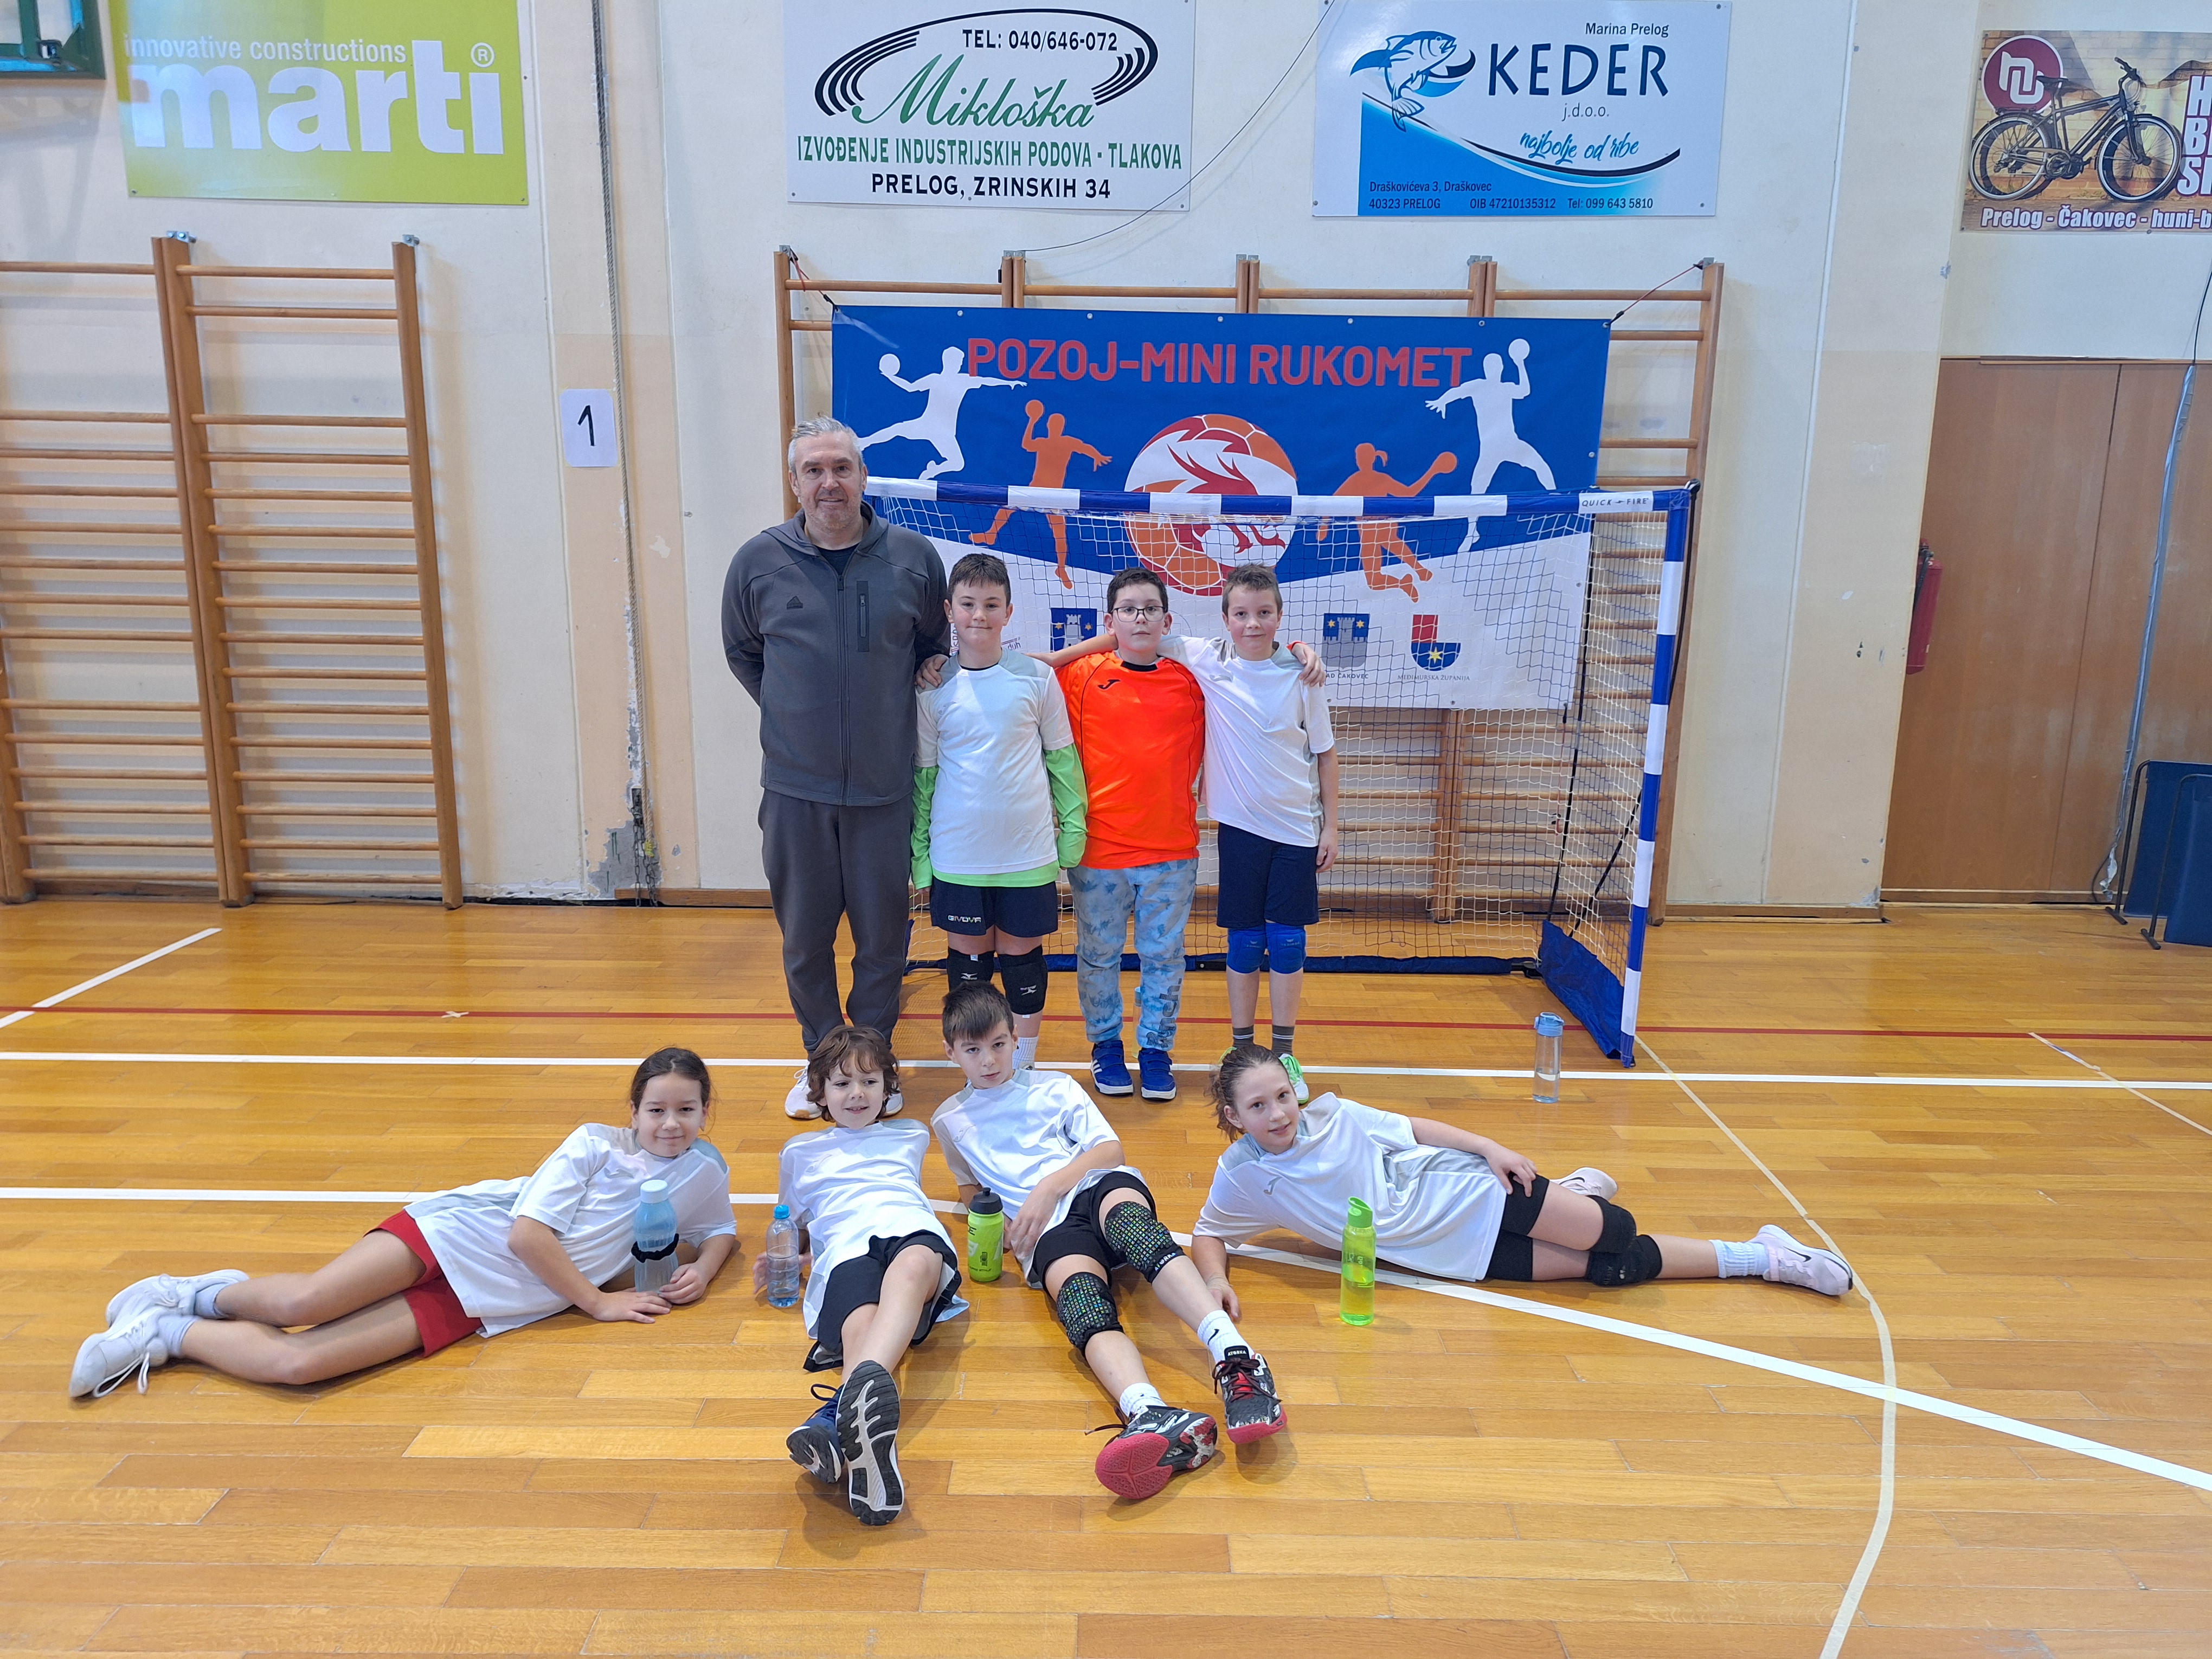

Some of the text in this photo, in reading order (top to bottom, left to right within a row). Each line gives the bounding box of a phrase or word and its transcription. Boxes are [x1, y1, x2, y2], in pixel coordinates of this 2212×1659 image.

[962, 29, 1118, 53] TEL: 040/646-072
[1585, 22, 1669, 38] Marina Prelog
[124, 34, 406, 64] innovative constructions
[1488, 42, 1669, 97] KEDER
[128, 40, 504, 155] marti
[852, 53, 1095, 128] Mikloška
[1561, 102, 1610, 122] j.d.o.o.
[797, 136, 889, 163] IZVOĐENJE
[896, 138, 1021, 166] INDUSTRIJSKIH
[1030, 141, 1091, 168] PODOVA
[1108, 143, 1182, 169] TLAKOVA
[1519, 130, 1639, 165] najbolje od ribe
[872, 173, 1111, 200] PRELOG, ZRINSKIH 34
[1369, 180, 1492, 193] Draškovićeva 3, Draškovec
[1368, 197, 1654, 209] 40323 PRELOG OIB 47210135312 Tel: 099 643 5810
[1980, 207, 2043, 229] Prelog
[2057, 204, 2137, 228] Čakovec
[967, 337, 1473, 388] POZOJ-MINI RUKOMET
[577, 405, 595, 446] 1
[1581, 499, 1613, 507] QUICK
[948, 915, 981, 923] GIVOVA
